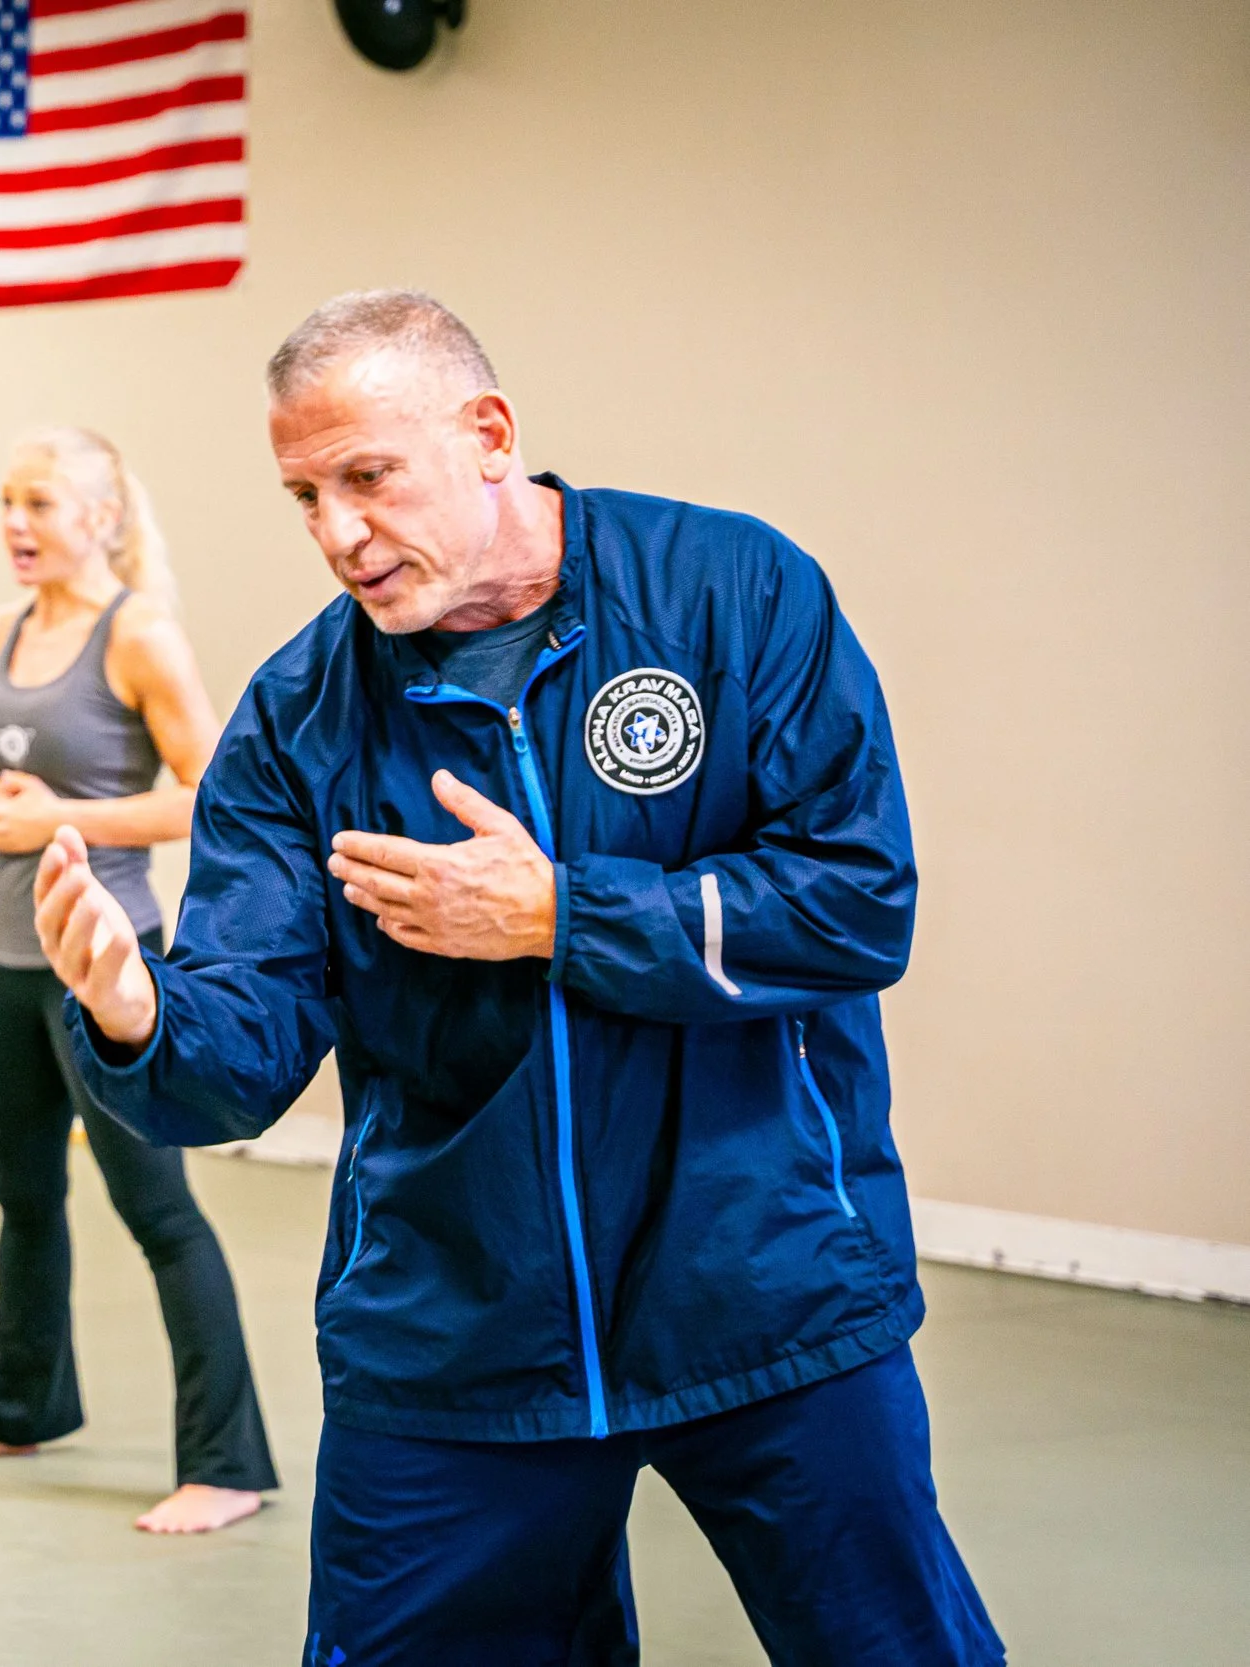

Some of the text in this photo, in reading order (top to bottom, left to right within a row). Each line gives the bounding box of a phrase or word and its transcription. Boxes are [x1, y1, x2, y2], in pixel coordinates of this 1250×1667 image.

[592, 678, 700, 772] ALPHA KRAV MAGA
